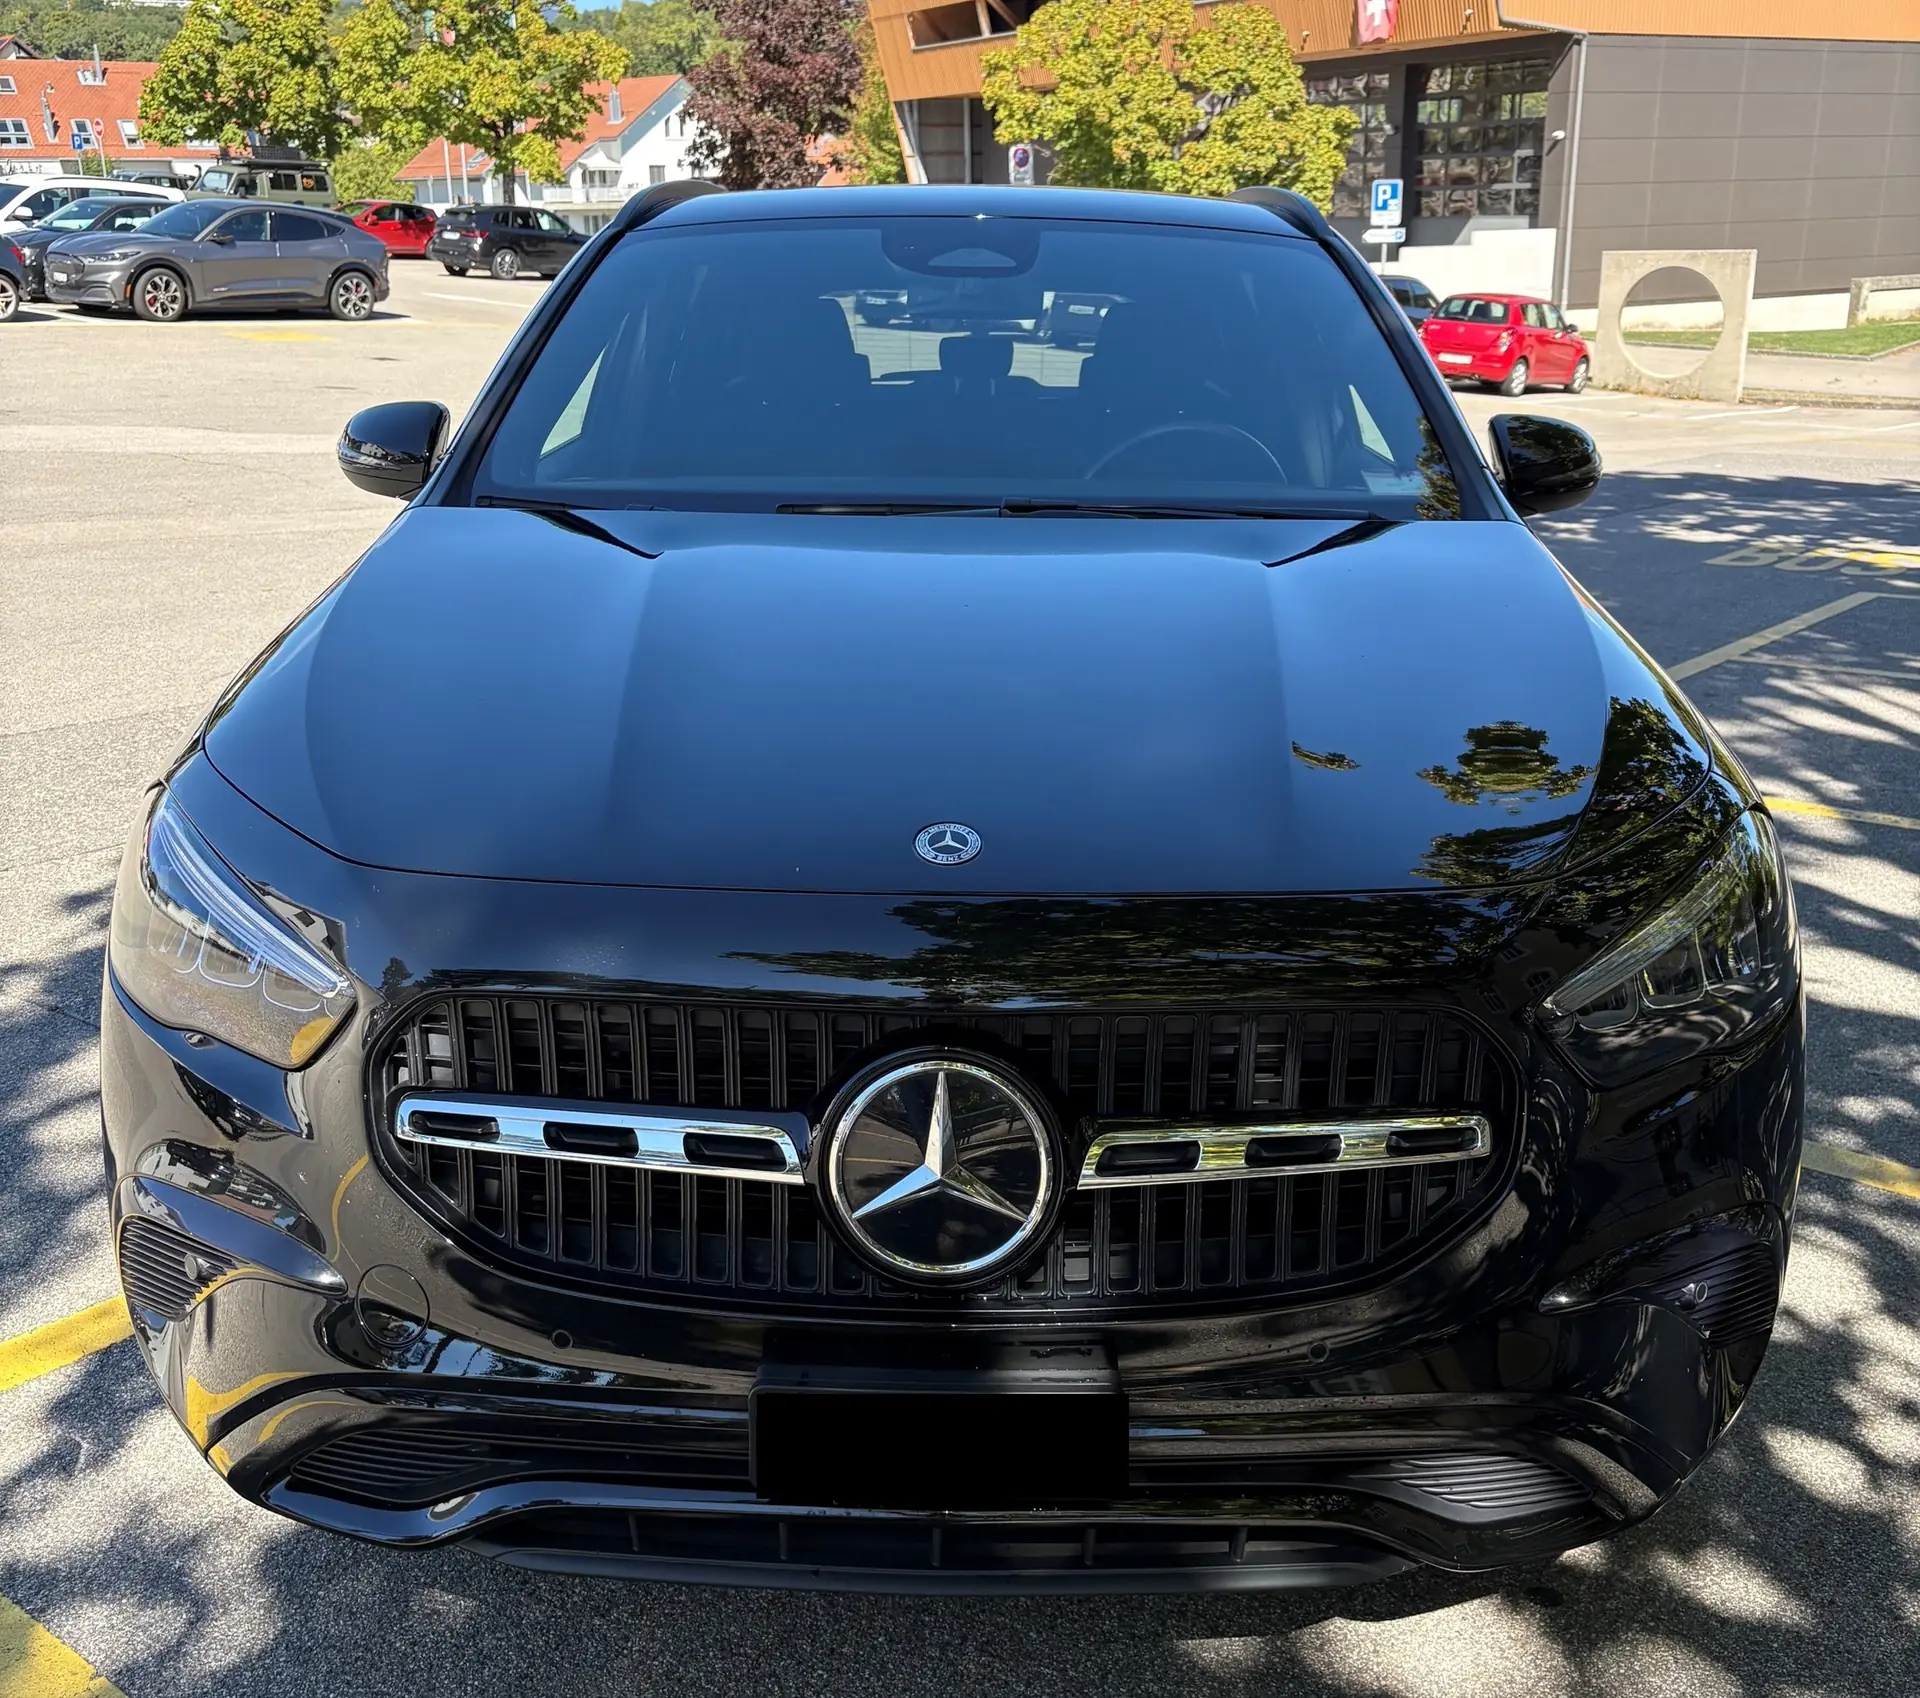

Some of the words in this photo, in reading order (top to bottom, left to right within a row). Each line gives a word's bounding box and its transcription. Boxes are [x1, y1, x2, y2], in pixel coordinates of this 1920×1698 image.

[74, 135, 81, 149] P
[1378, 185, 1391, 207] P
[936, 854, 960, 862] BENZ
